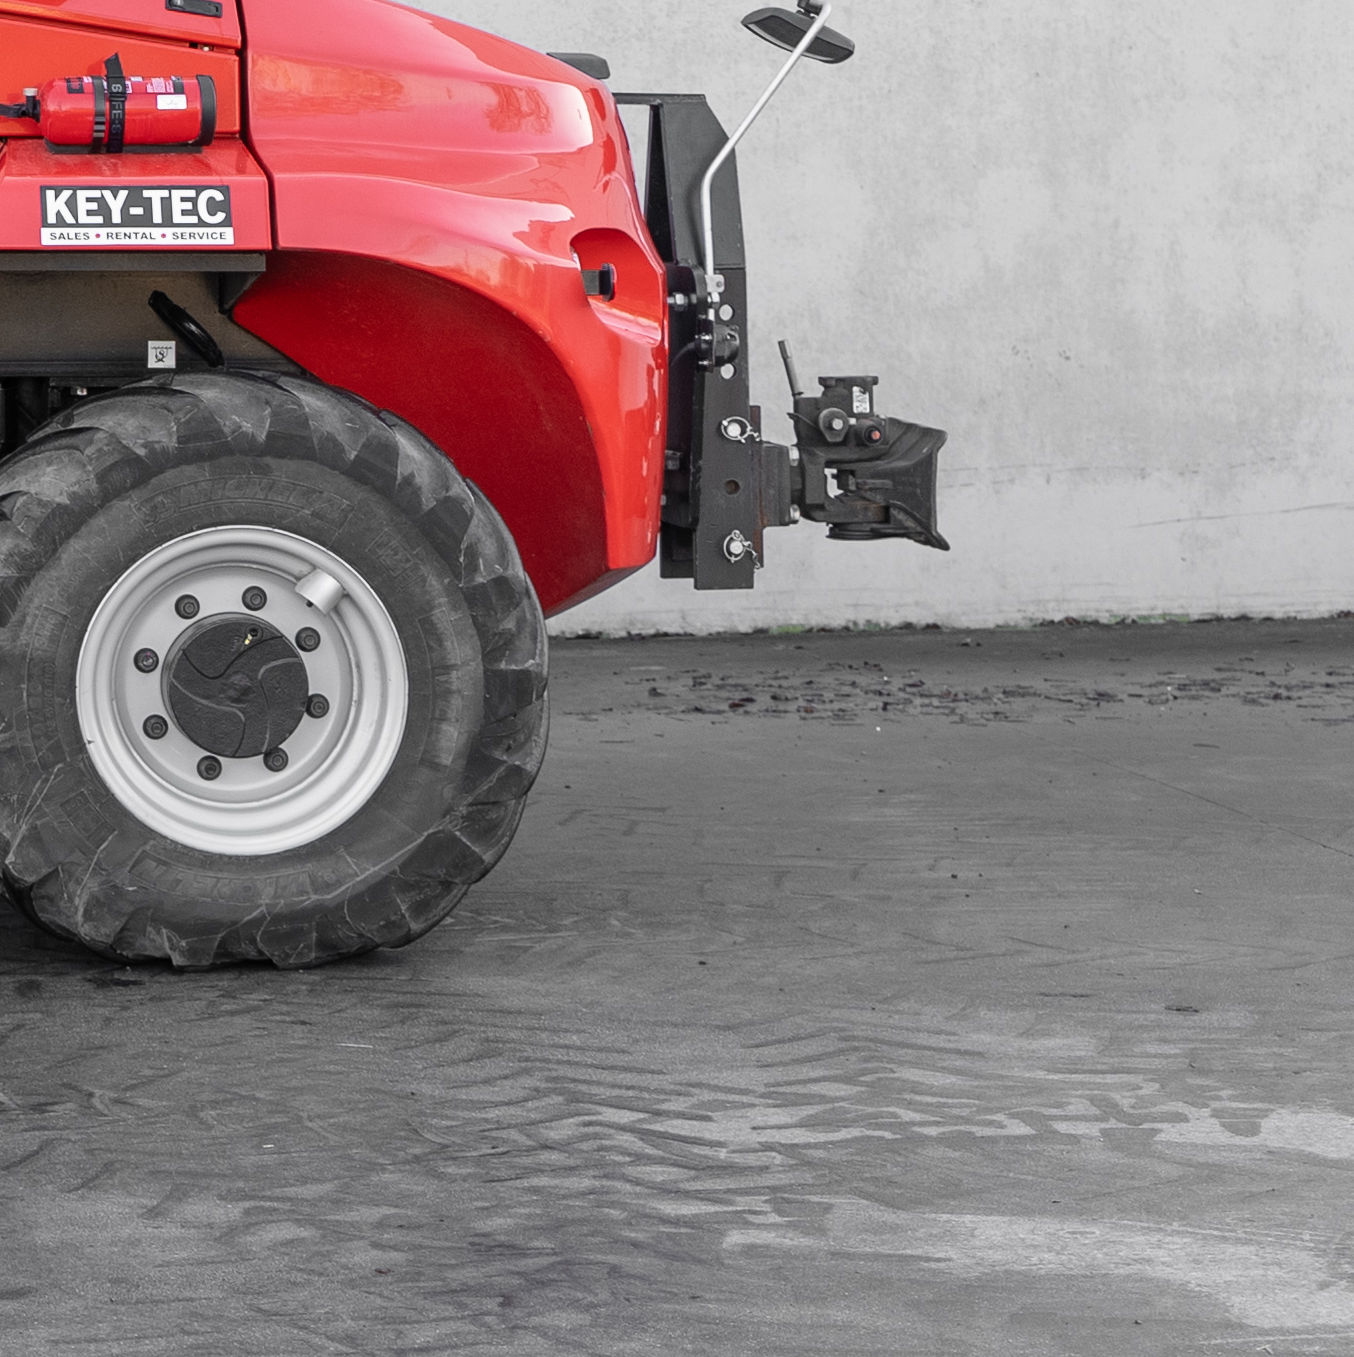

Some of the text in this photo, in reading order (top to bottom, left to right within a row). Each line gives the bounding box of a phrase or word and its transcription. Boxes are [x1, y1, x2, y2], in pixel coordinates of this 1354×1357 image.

[45, 189, 227, 224] KEY-TEC
[49, 232, 227, 241] SALES RENTAL SERVICE
